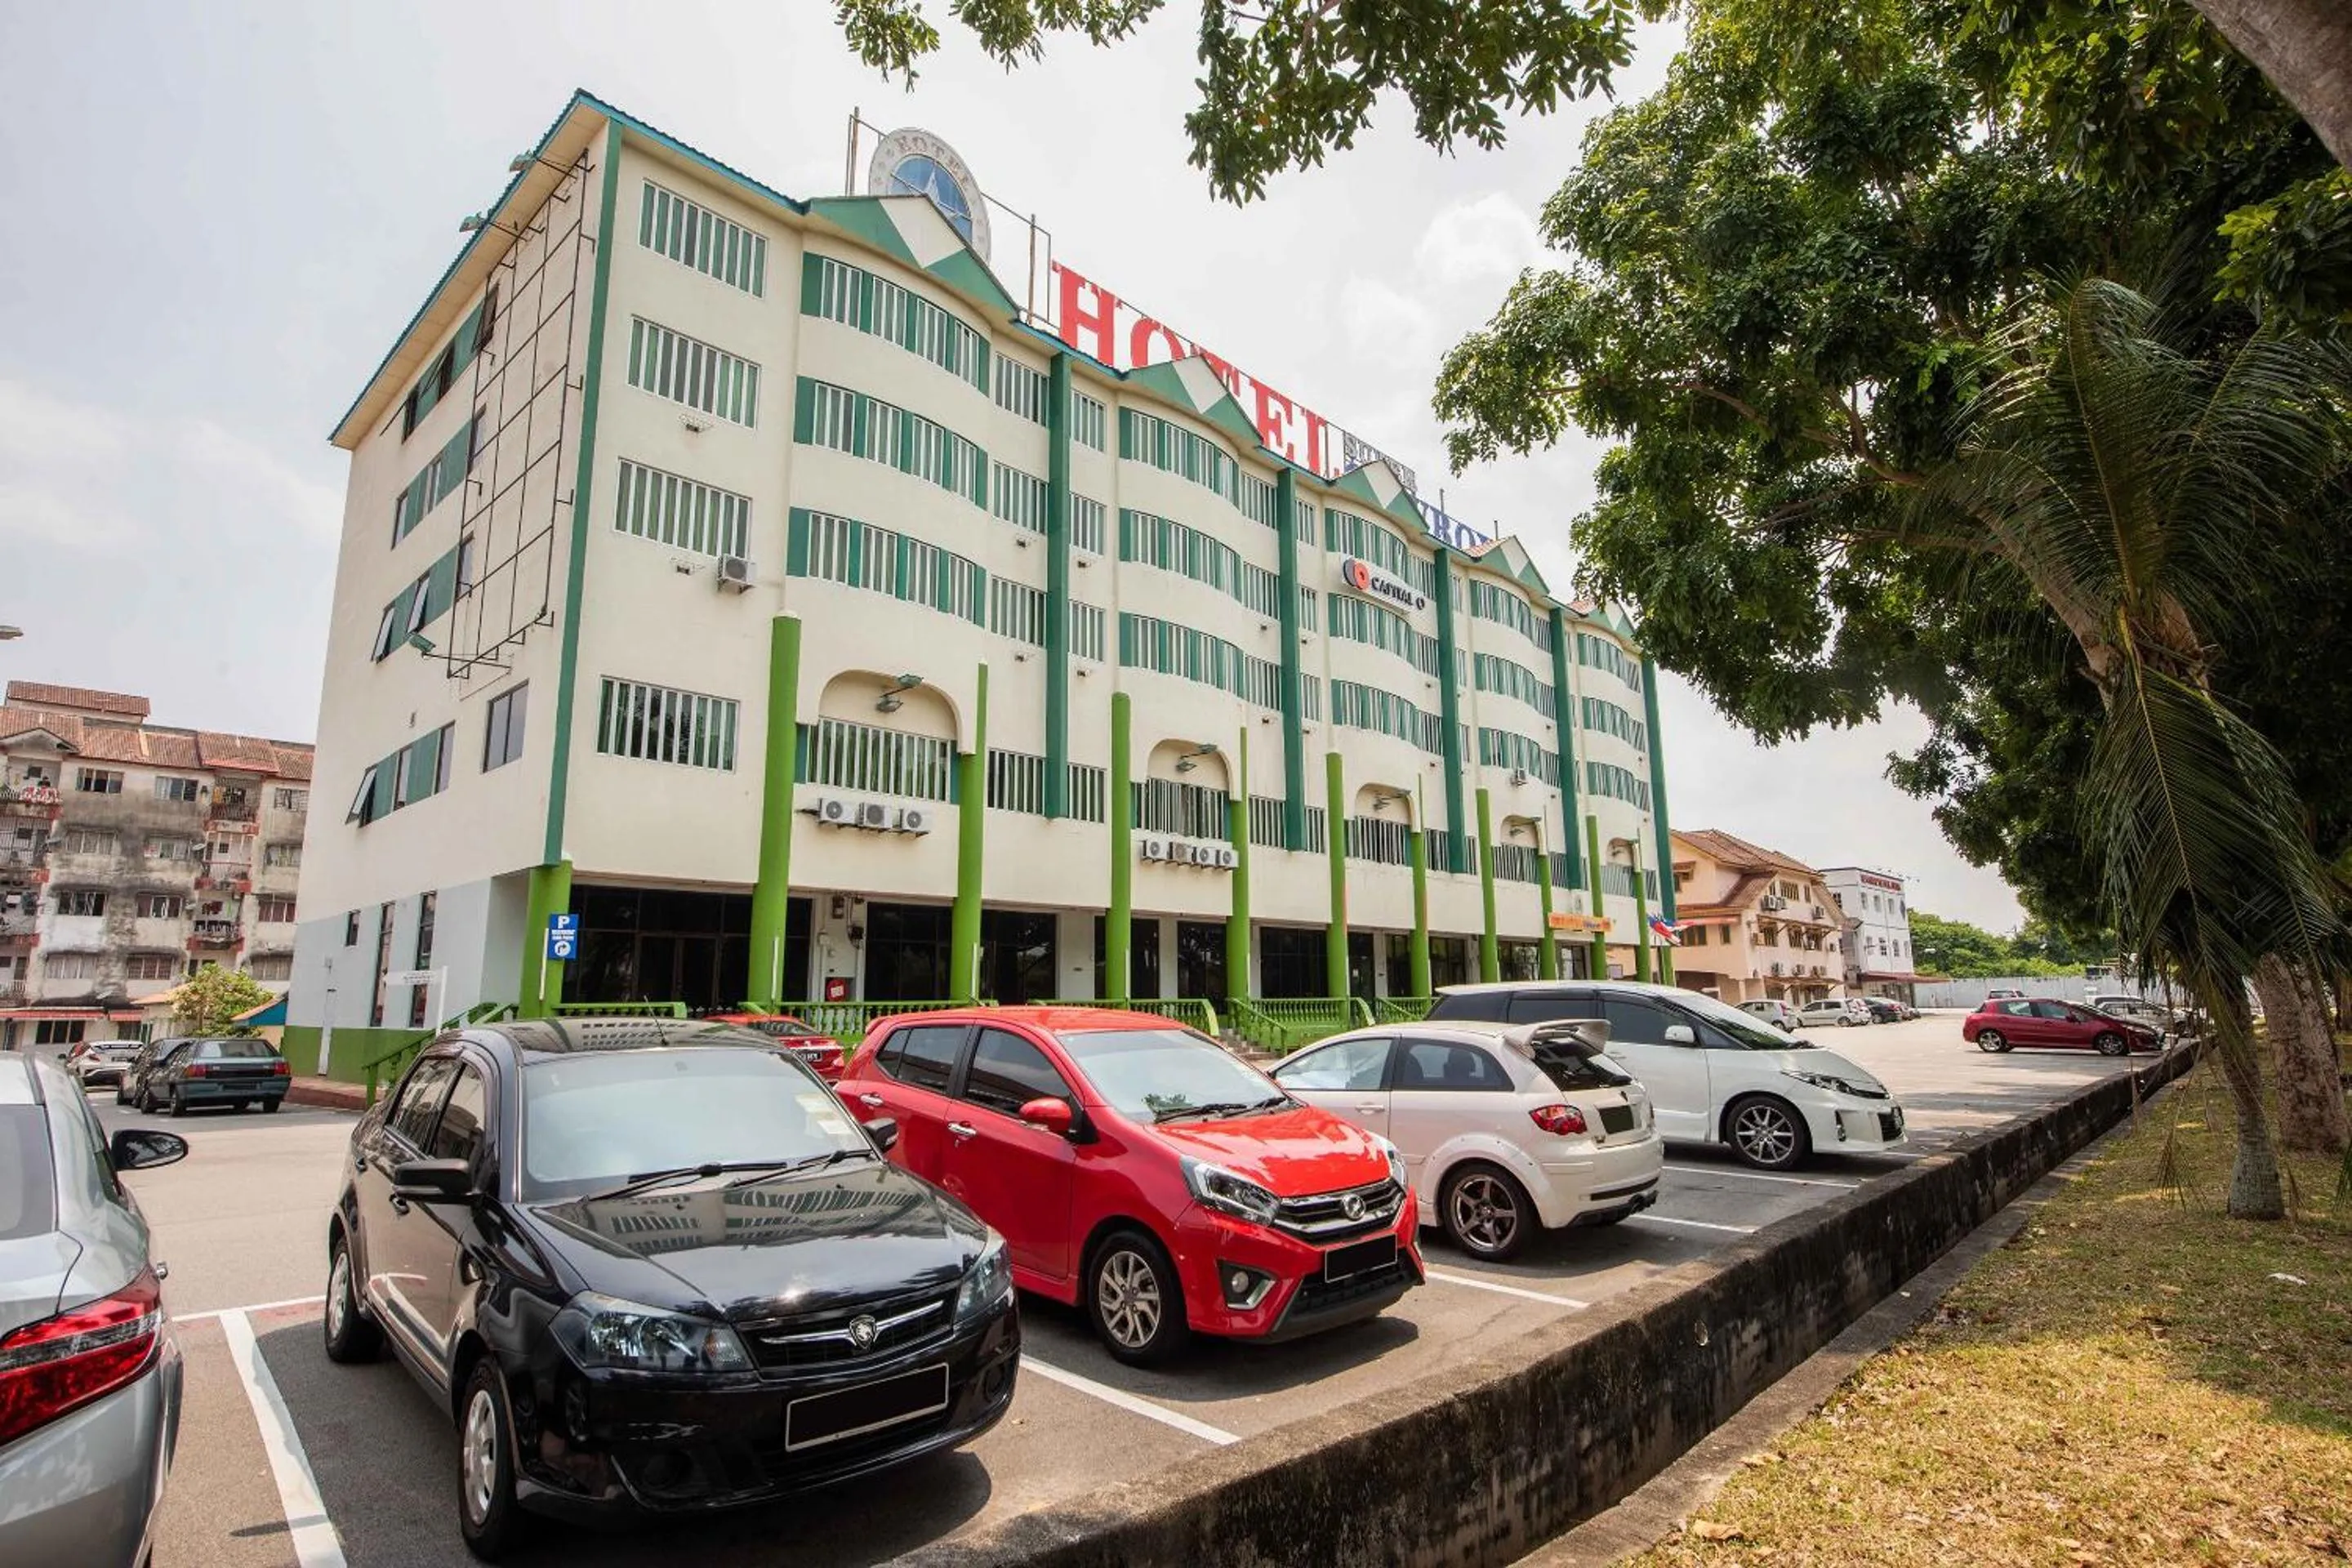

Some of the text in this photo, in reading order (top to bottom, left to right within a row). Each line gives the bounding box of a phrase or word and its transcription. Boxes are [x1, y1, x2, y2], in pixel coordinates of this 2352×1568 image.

[1371, 577, 1426, 611] CAPITAL O
[558, 915, 570, 929] P
